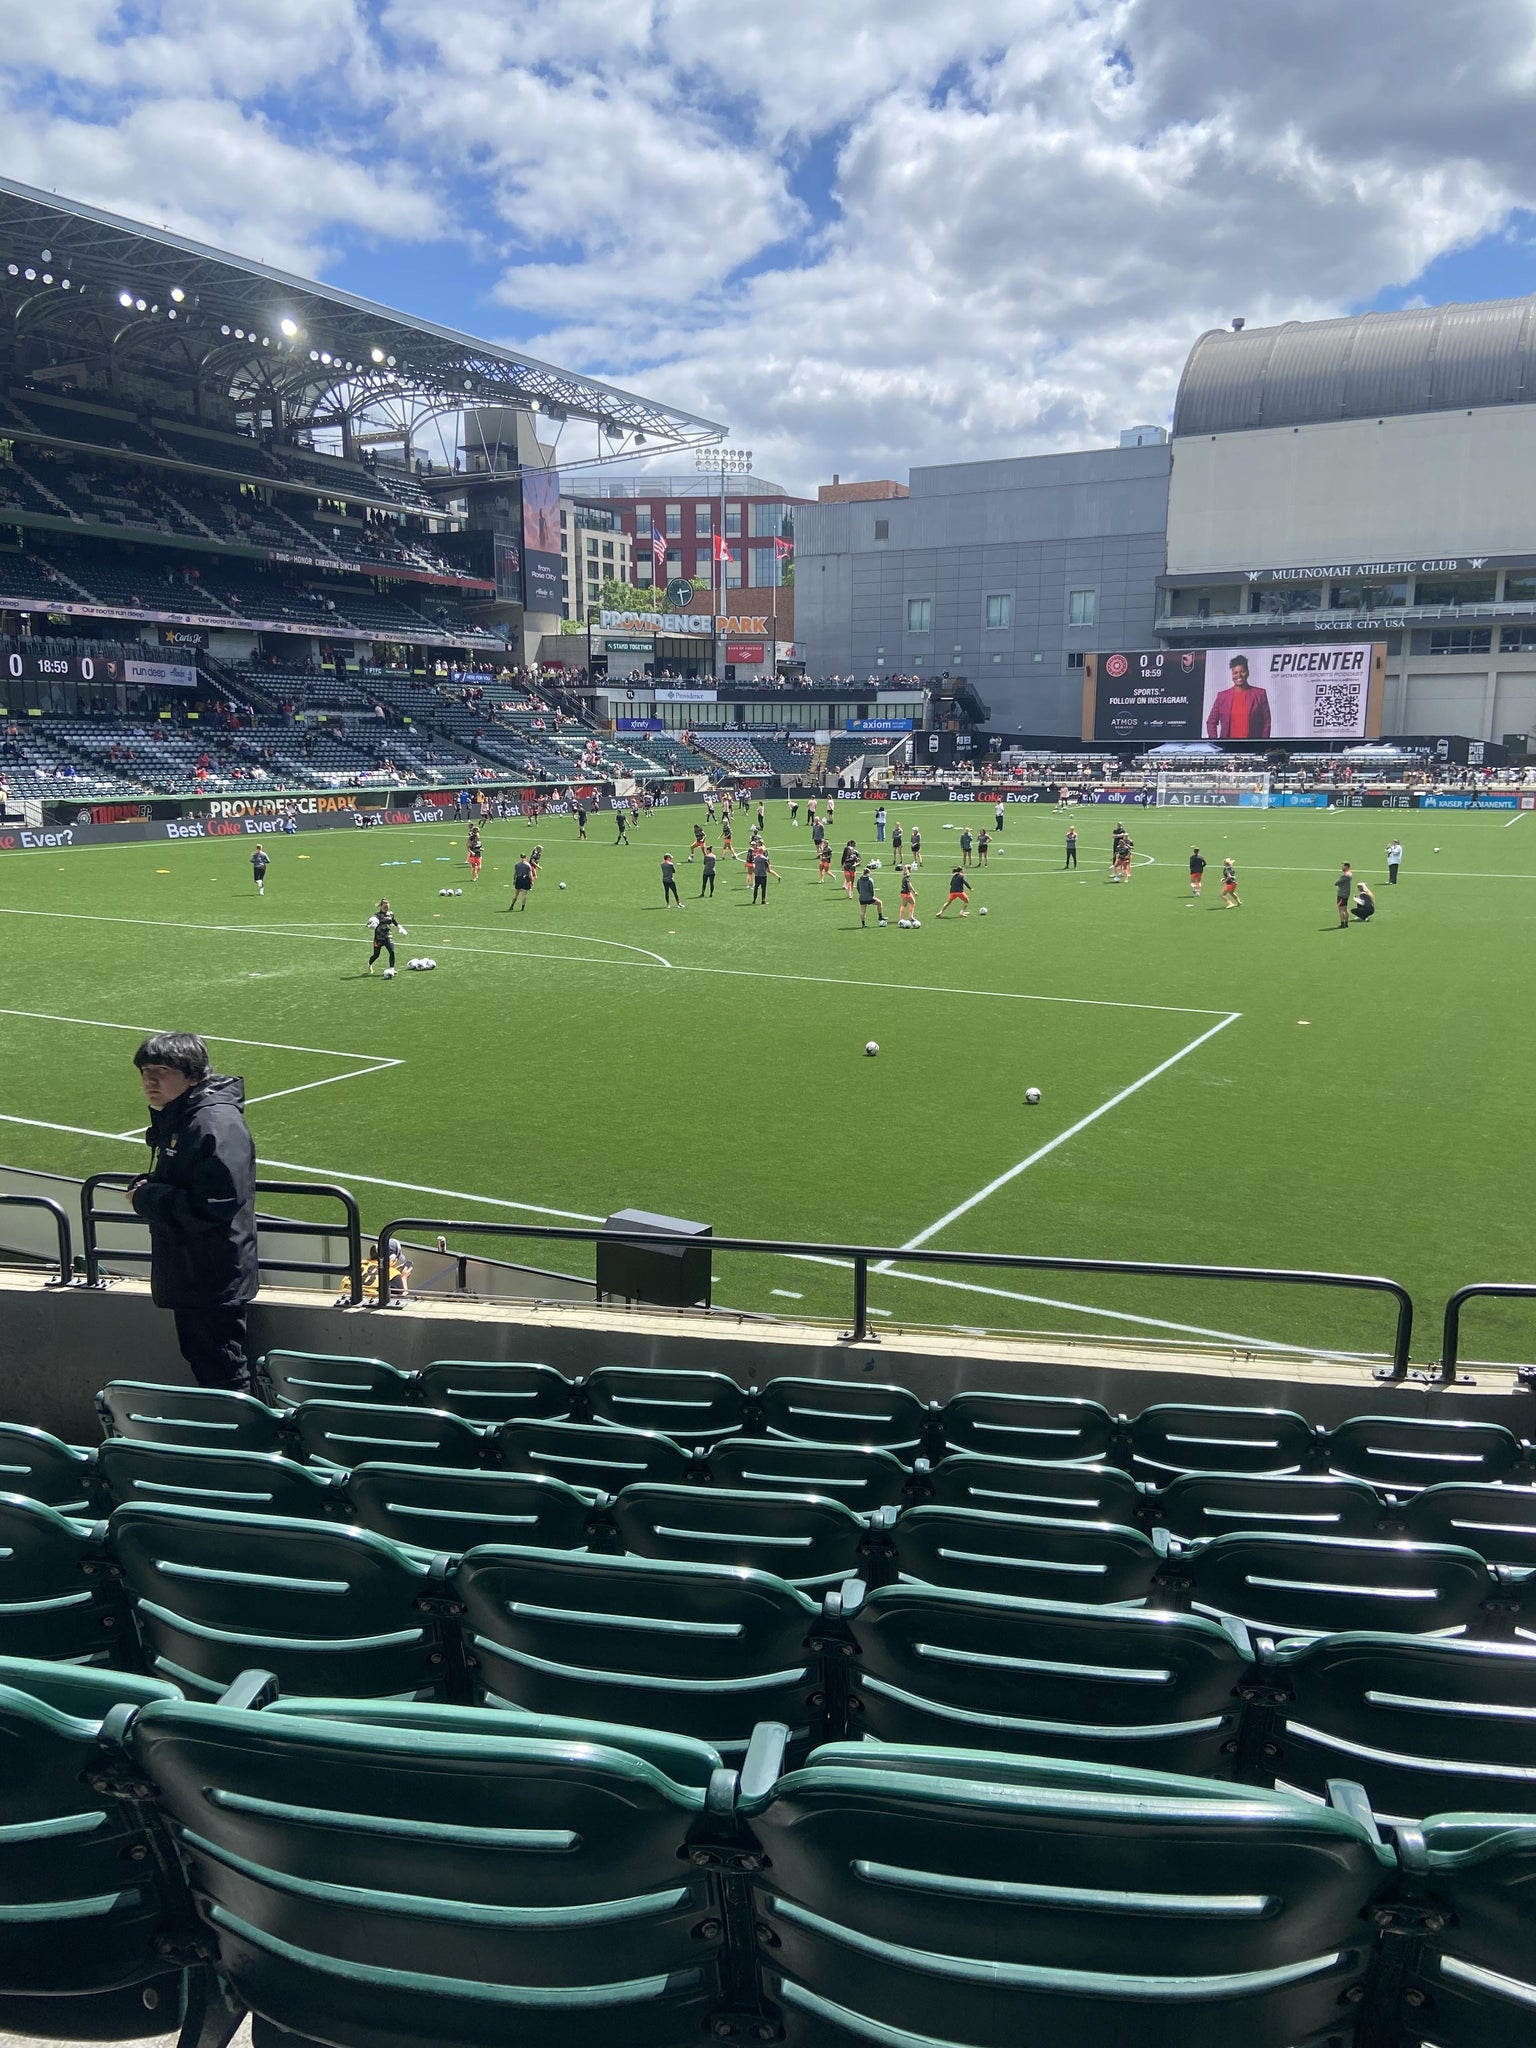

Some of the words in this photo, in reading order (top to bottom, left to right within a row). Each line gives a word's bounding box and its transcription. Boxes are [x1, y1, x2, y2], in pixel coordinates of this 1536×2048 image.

[538, 564, 551, 572] from
[1272, 567, 1351, 580] MULTNOMAH
[1355, 562, 1417, 575] ATHLETIC
[1422, 560, 1458, 571] CLUB
[532, 571, 545, 579] Rose
[545, 573, 557, 581] City
[82, 606, 94, 614] Our
[96, 608, 114, 616] roots
[600, 609, 712, 634] PROVIDENCE
[716, 615, 769, 635] PARK
[1314, 621, 1352, 631] SOCCER
[1356, 620, 1381, 630] CITY
[1385, 619, 1405, 629] USA
[629, 643, 653, 651] TOGETHER
[9, 653, 23, 677] 0
[38, 659, 69, 674] 18:59
[1140, 654, 1148, 667] 0
[1156, 654, 1164, 667] 0
[1269, 651, 1365, 673] EPICENTER
[81, 657, 94, 680] 0
[132, 667, 147, 676] run
[148, 667, 166, 679] deep
[1141, 669, 1162, 677] 18:59
[1109, 697, 1135, 705] FOLLOW
[631, 719, 649, 729] xfinity
[863, 720, 891, 729] axiom
[1470, 746, 1484, 754] PUB
[837, 789, 861, 799] Best
[863, 789, 887, 800] Coke
[890, 791, 920, 801] Ever?
[949, 792, 975, 802] Best
[977, 791, 1003, 802] Coke
[1006, 793, 1039, 803] Ever?
[1108, 792, 1127, 804] ally
[1183, 795, 1227, 804] DELTA
[317, 796, 357, 813] PARK
[611, 798, 630, 810] Best
[1439, 801, 1463, 809] KAISER
[91, 804, 138, 824] THORNS
[384, 810, 411, 825] Coke
[413, 808, 444, 822] Ever?
[166, 822, 205, 839] Best
[207, 820, 241, 836] Coke
[244, 818, 284, 834] Ever?
[20, 829, 73, 848] Ever?
